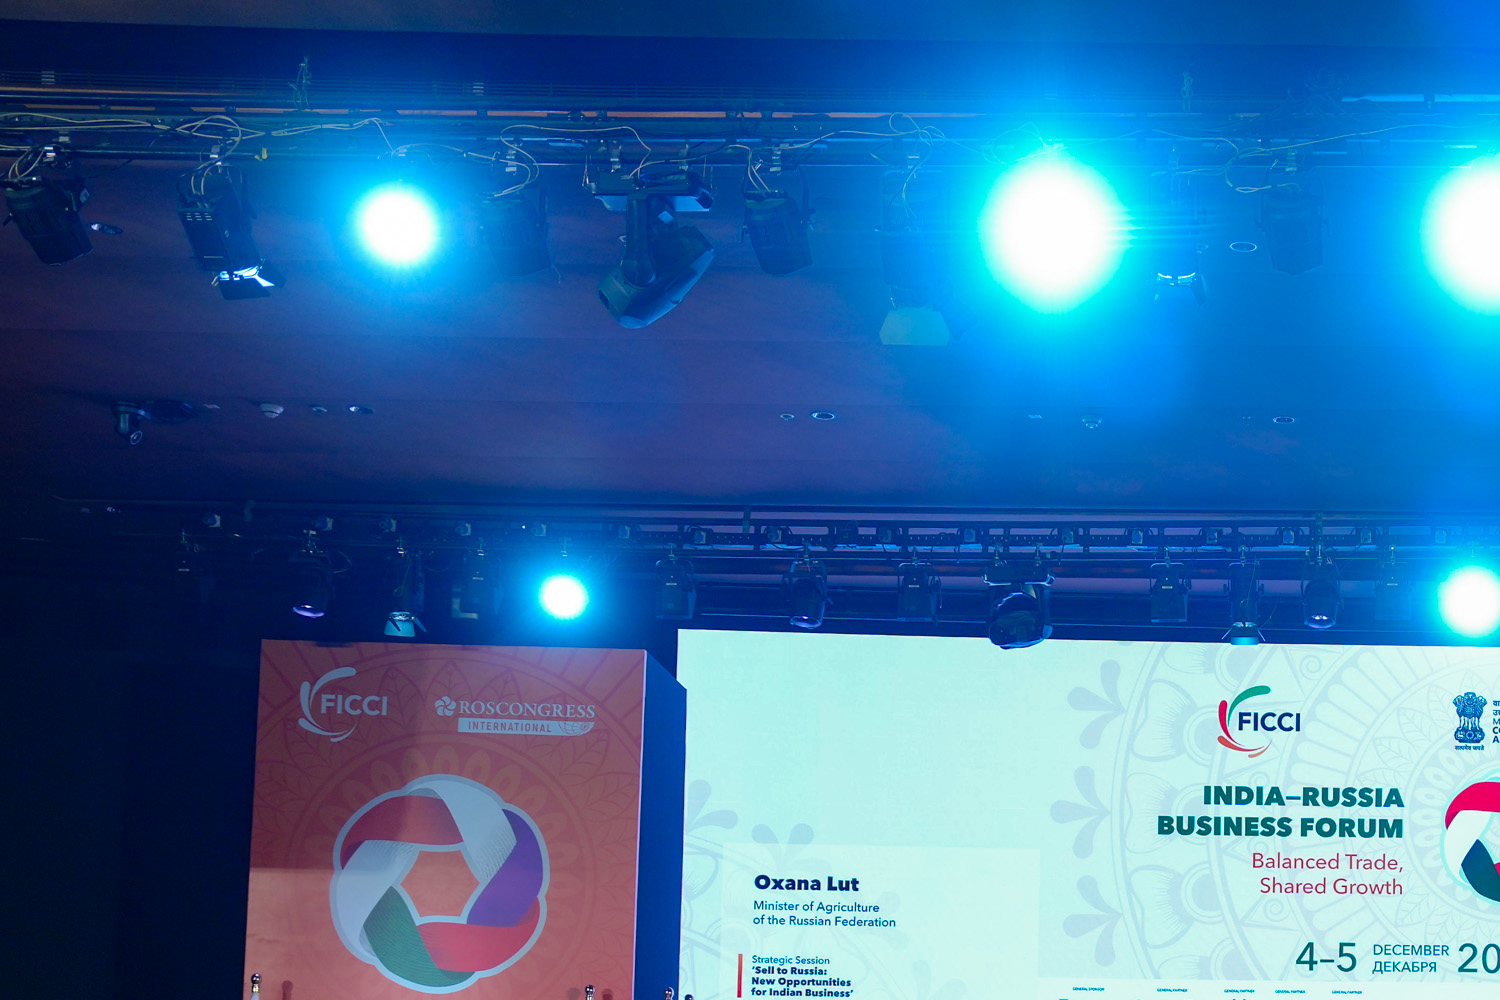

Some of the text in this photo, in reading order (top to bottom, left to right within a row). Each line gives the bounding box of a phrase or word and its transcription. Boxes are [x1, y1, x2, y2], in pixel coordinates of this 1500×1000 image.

[320, 694, 388, 716] FICCI
[459, 700, 595, 718] ROSCONGRESS
[468, 721, 552, 733] INTERNATIONAL
[1238, 712, 1301, 732] FICCI
[1157, 815, 1403, 839] BUSINESS FORUM
[1252, 852, 1403, 873] Balanced Trade,
[754, 875, 859, 892] Oxana Lut
[1260, 877, 1403, 896] Shared Growth
[754, 900, 880, 914] Minister of Agriculture
[753, 915, 896, 928] of the Russian Federation
[1373, 944, 1450, 957] DECEMBER
[752, 955, 830, 966] Strategic Session
[777, 967, 787, 976] to
[791, 967, 827, 977] Russia:
[1372, 961, 1437, 974] ДЕКАБРЯ
[752, 977, 851, 989] New Opportunities
[751, 988, 767, 997] for
[769, 988, 802, 998] Indian
